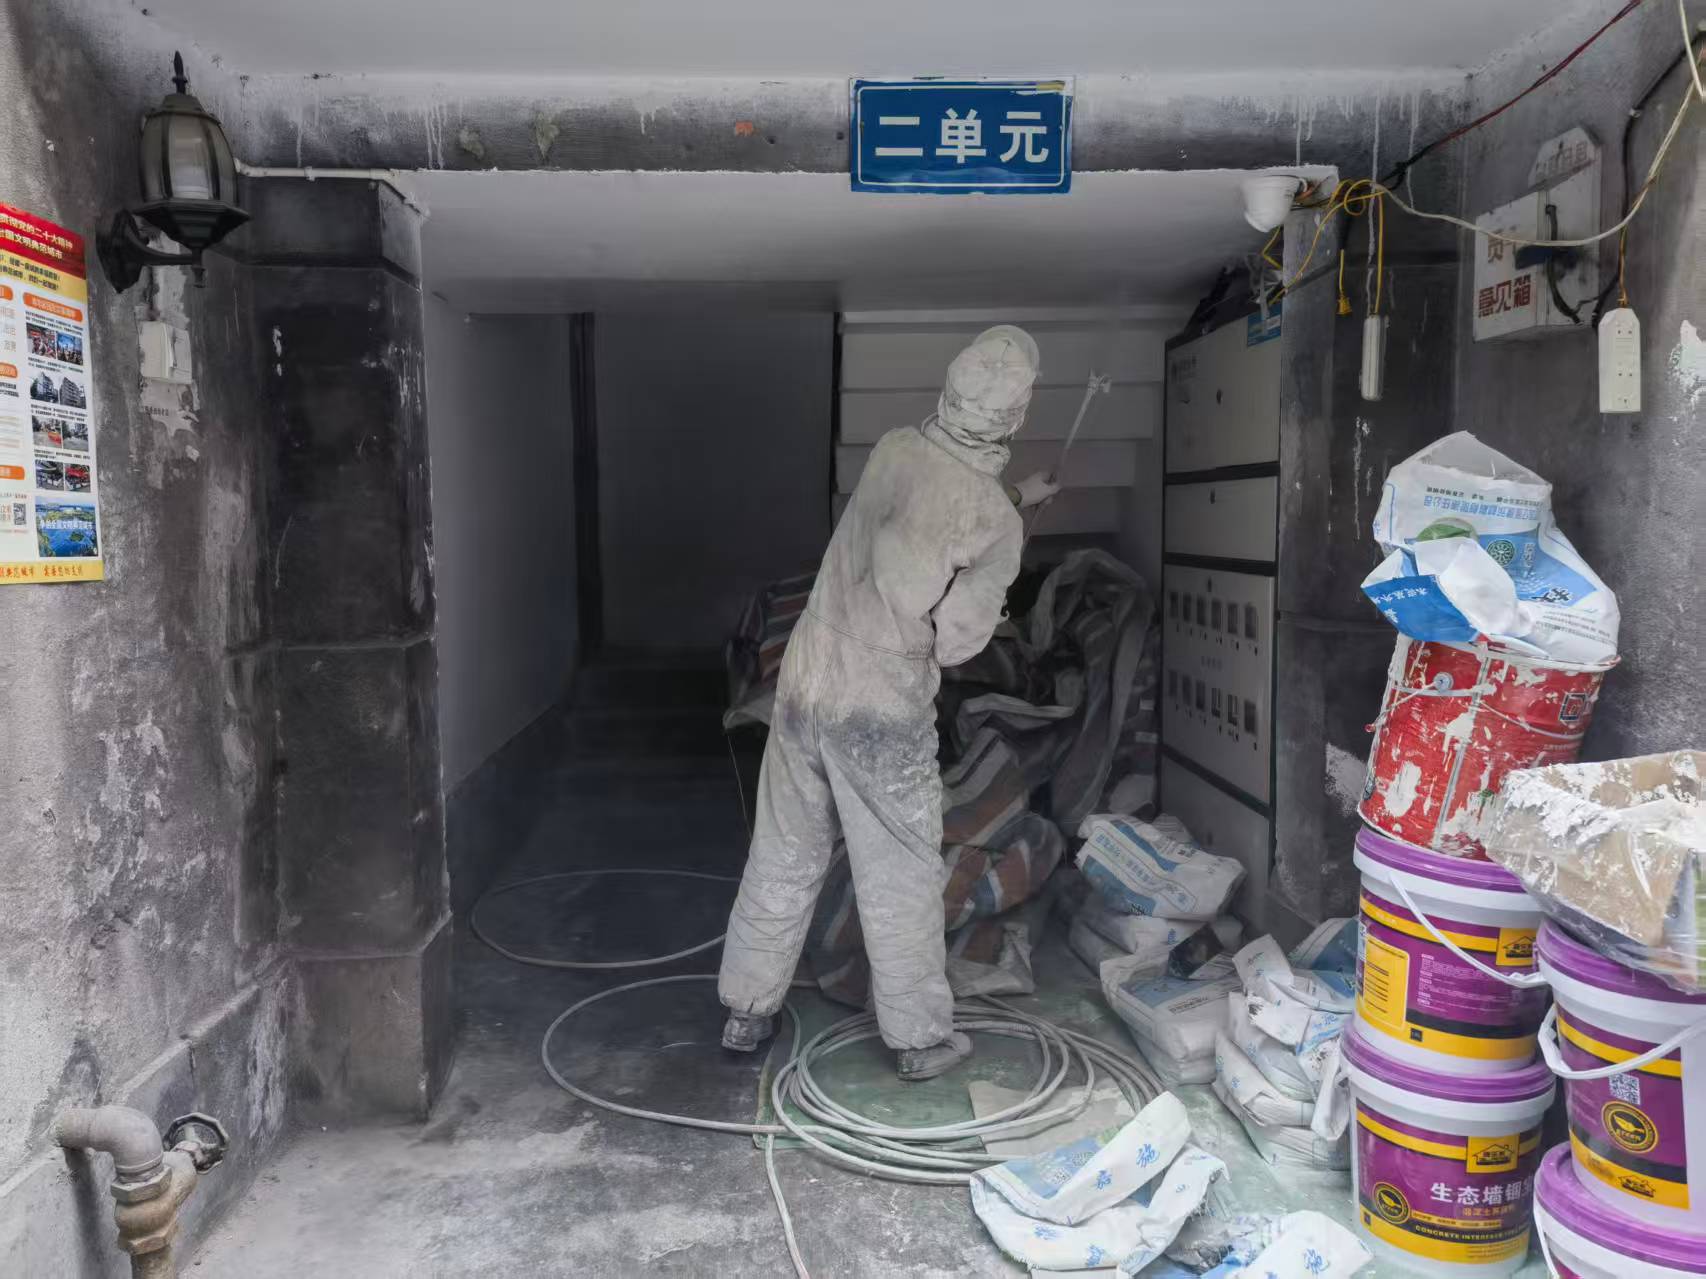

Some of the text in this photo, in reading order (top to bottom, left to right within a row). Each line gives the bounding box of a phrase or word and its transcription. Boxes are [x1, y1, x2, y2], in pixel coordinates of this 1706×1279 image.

[875, 108, 1049, 164] 二单元
[1479, 274, 1531, 318] 意见箱
[1415, 1225, 1459, 1240] CONCRETE
